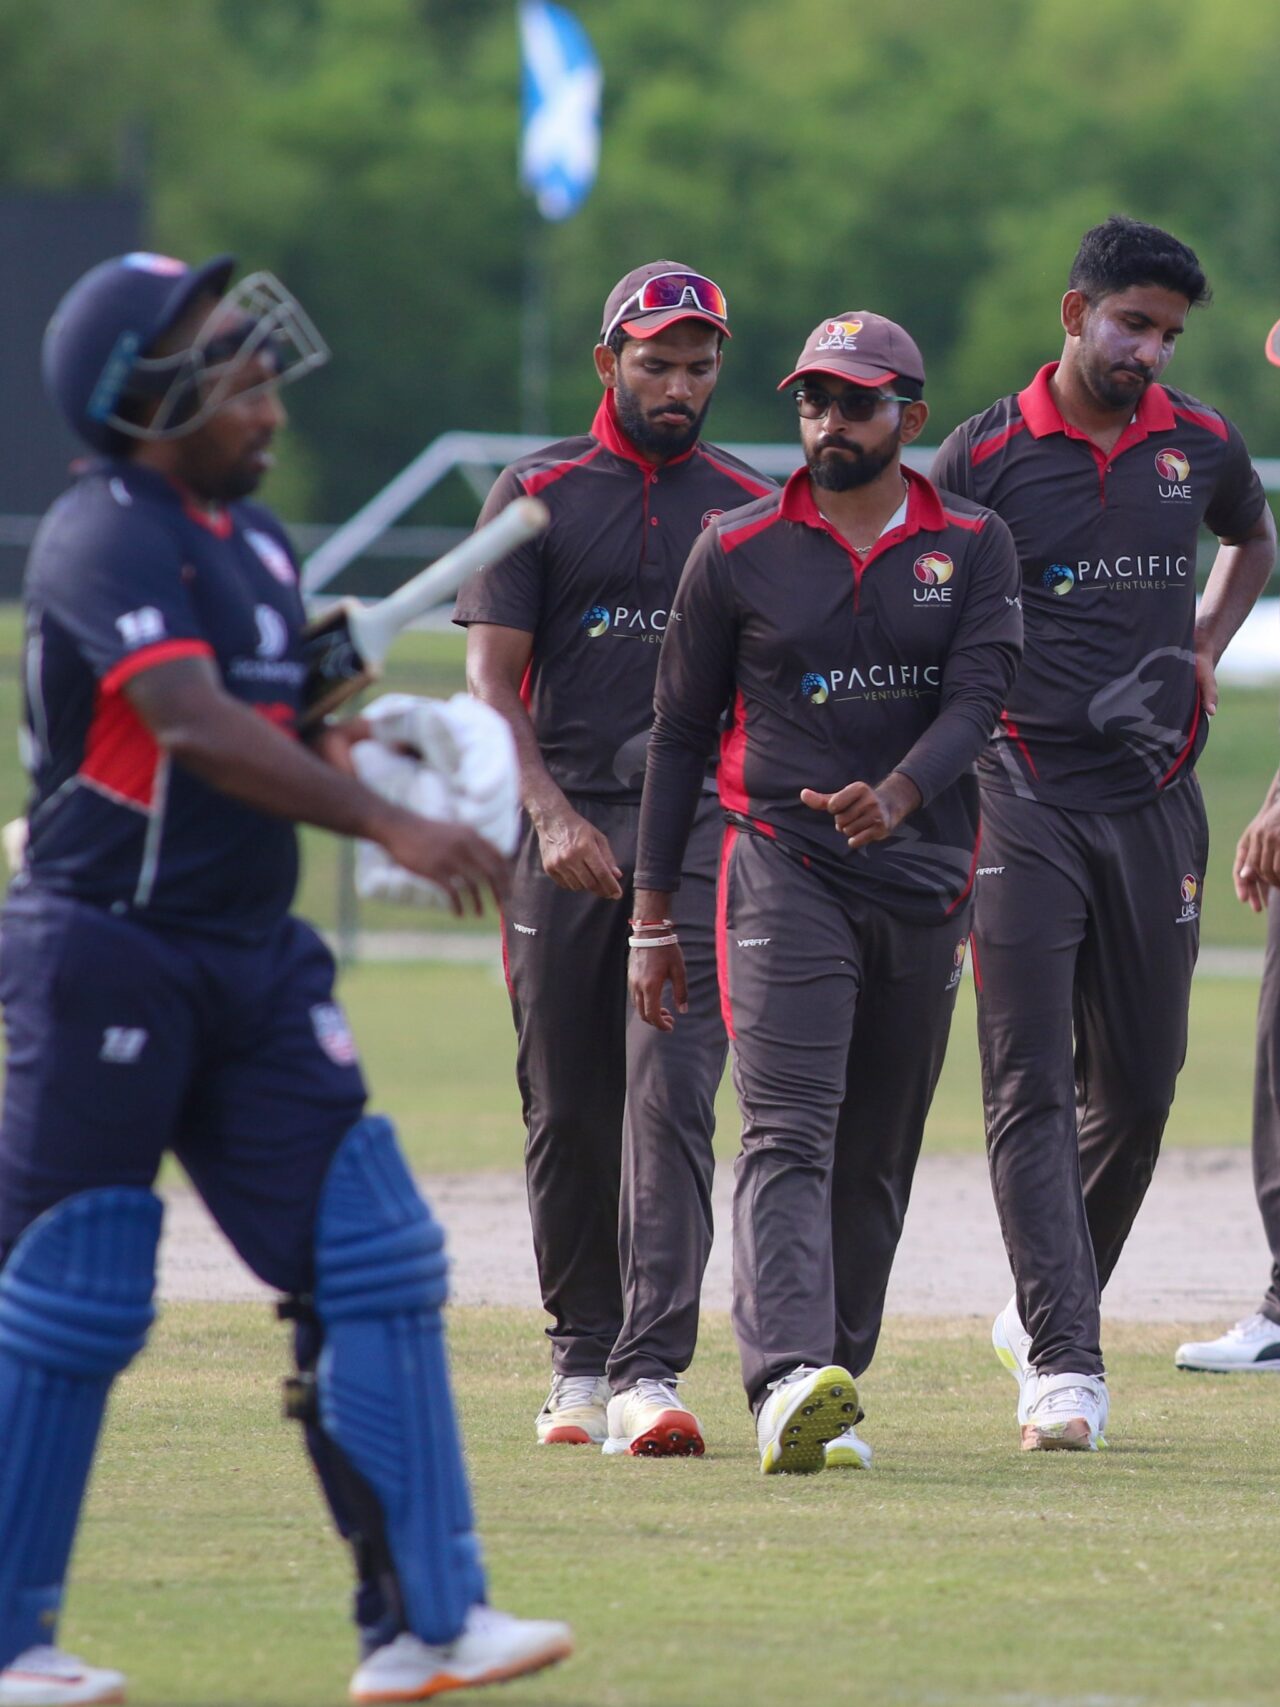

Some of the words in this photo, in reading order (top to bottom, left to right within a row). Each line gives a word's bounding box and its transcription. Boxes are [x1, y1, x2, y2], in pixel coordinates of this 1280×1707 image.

[819, 336, 857, 347] UAE
[1158, 484, 1192, 499] UAE
[1077, 556, 1188, 581] PACIFIC
[1108, 580, 1168, 591] VENTURES
[912, 588, 953, 602] UAE
[830, 665, 940, 692] PACIFIC
